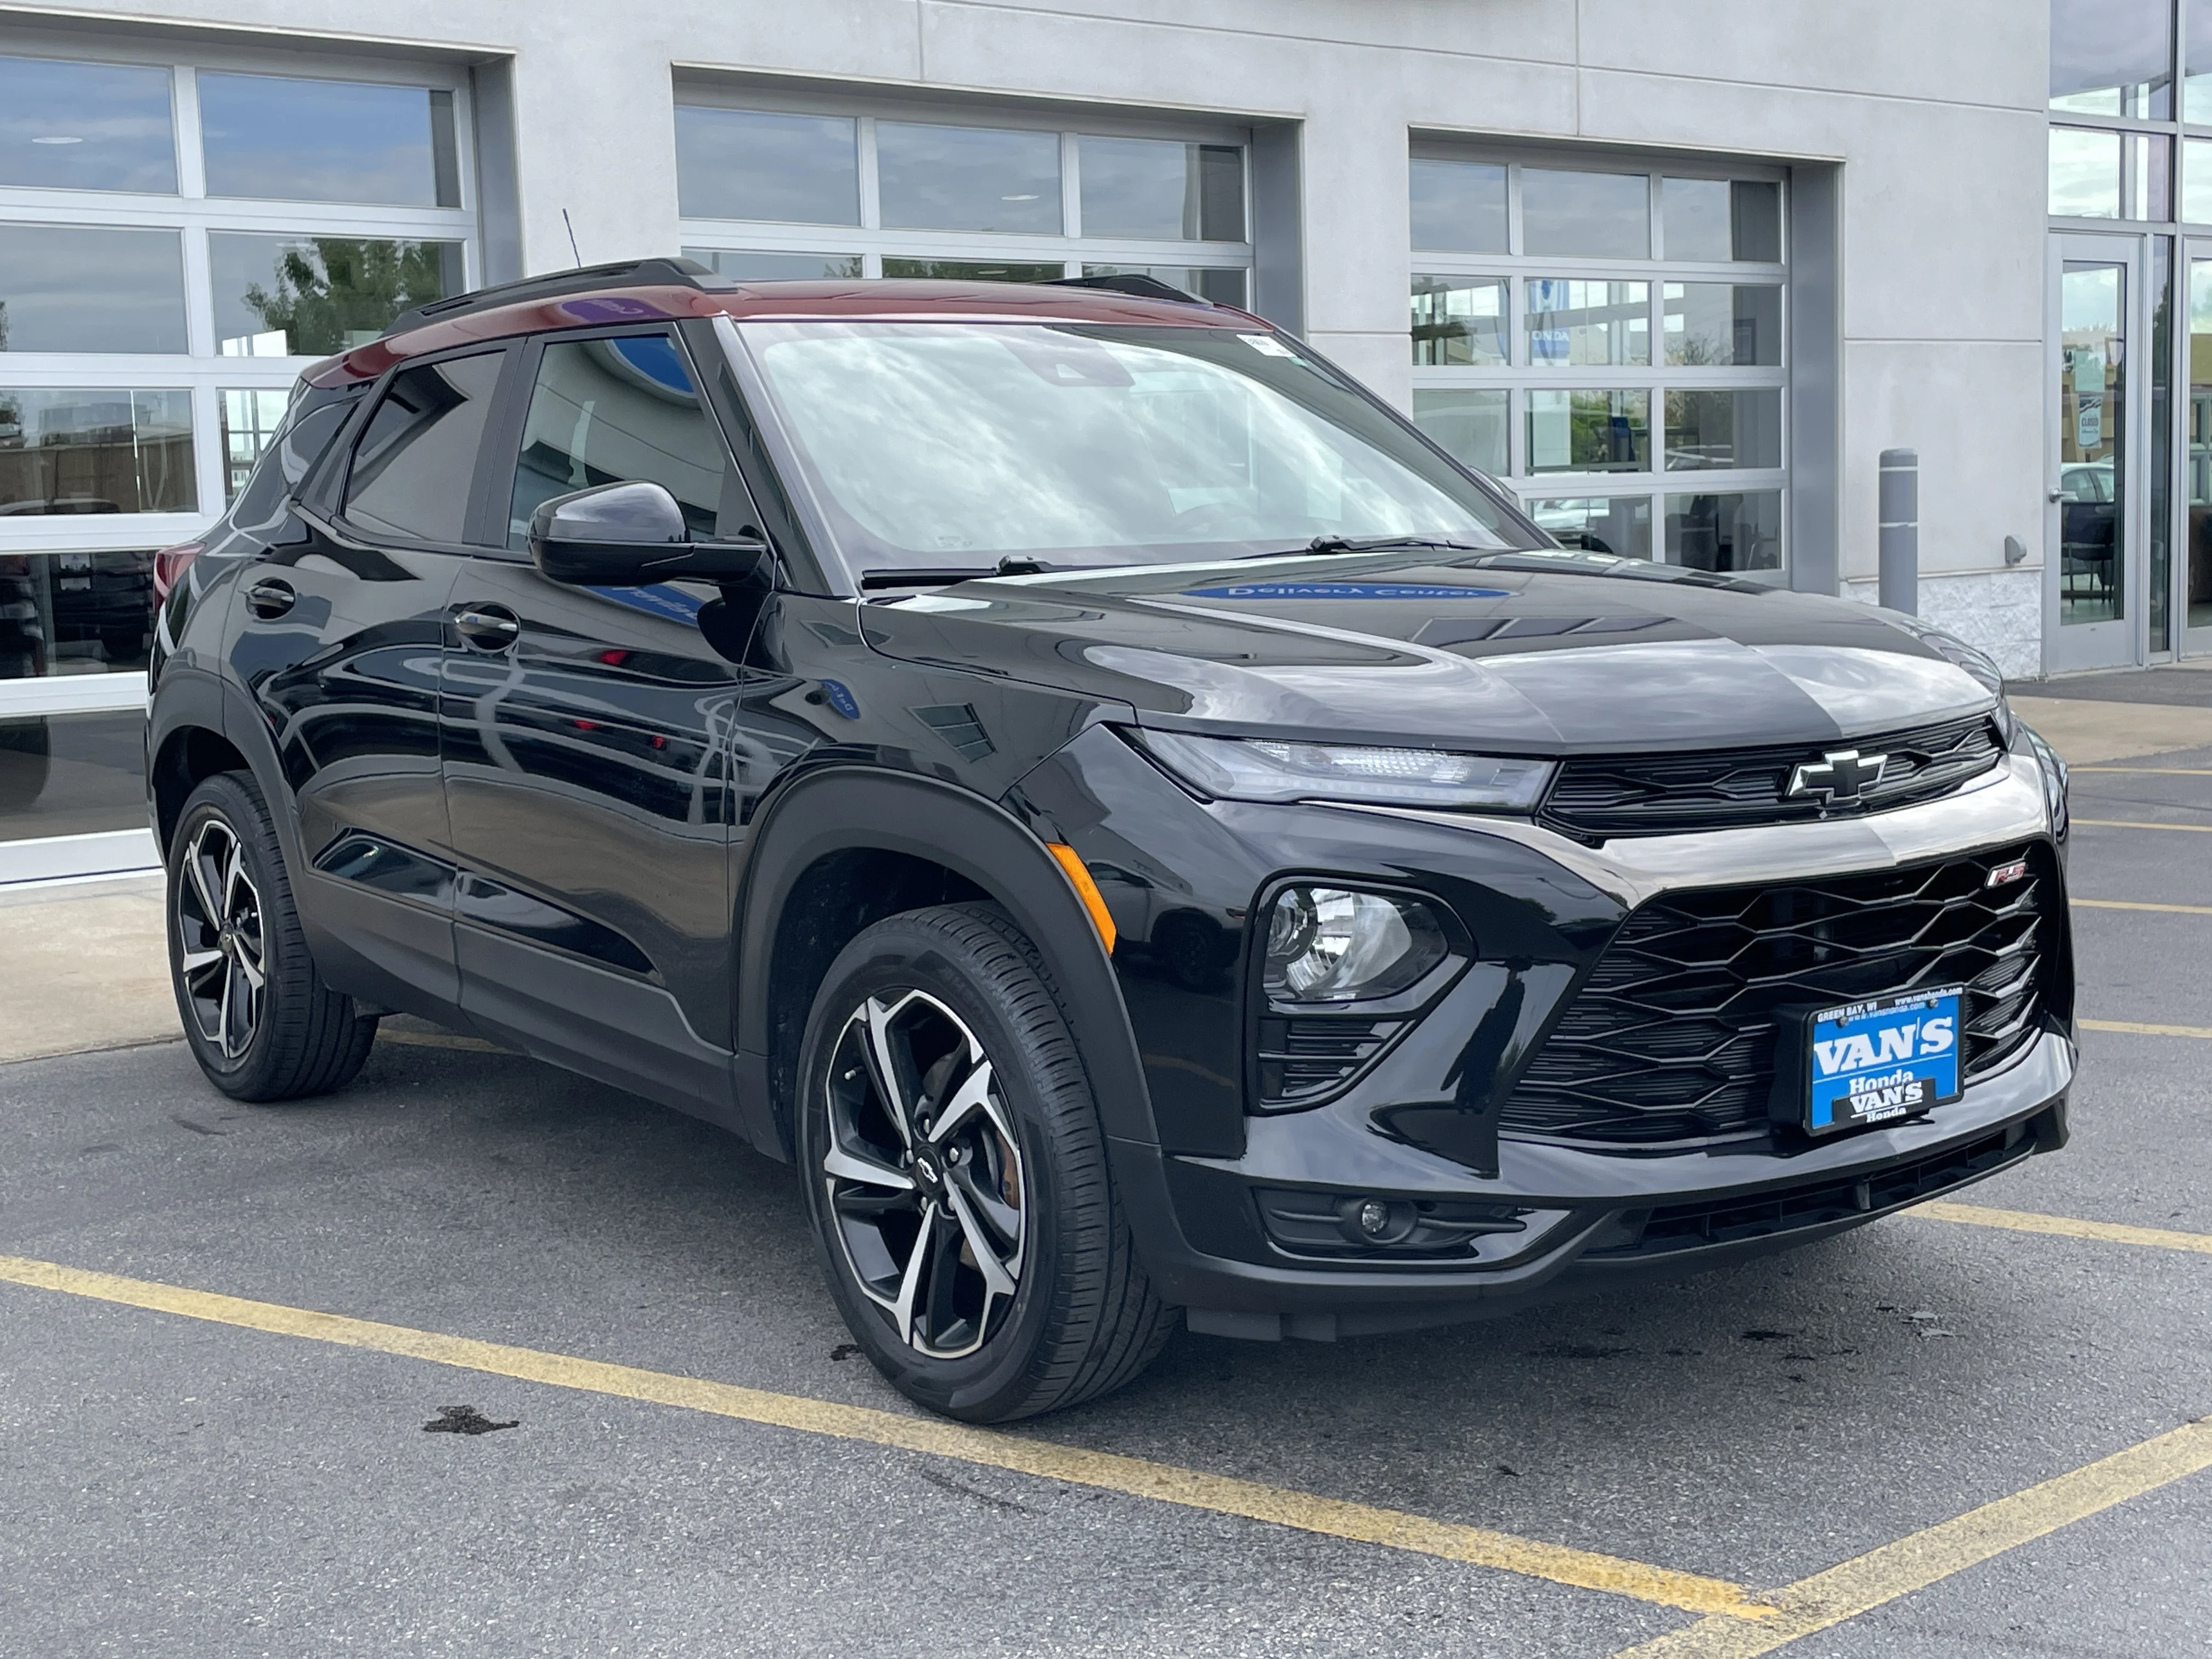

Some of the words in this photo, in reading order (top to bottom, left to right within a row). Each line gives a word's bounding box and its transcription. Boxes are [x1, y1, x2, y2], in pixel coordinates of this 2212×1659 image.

[1532, 331, 1570, 341] ONDA
[1987, 862, 2026, 887] RS
[1894, 987, 1962, 1006] www.vanshonda.com
[1818, 1008, 1844, 1023] GREEN
[1866, 1001, 1877, 1012] WI
[1814, 1017, 1954, 1075] VAN'S
[1849, 1069, 1914, 1095] Honda
[1850, 1081, 1923, 1113] VAN'S
[1866, 1107, 1906, 1123] Honda
